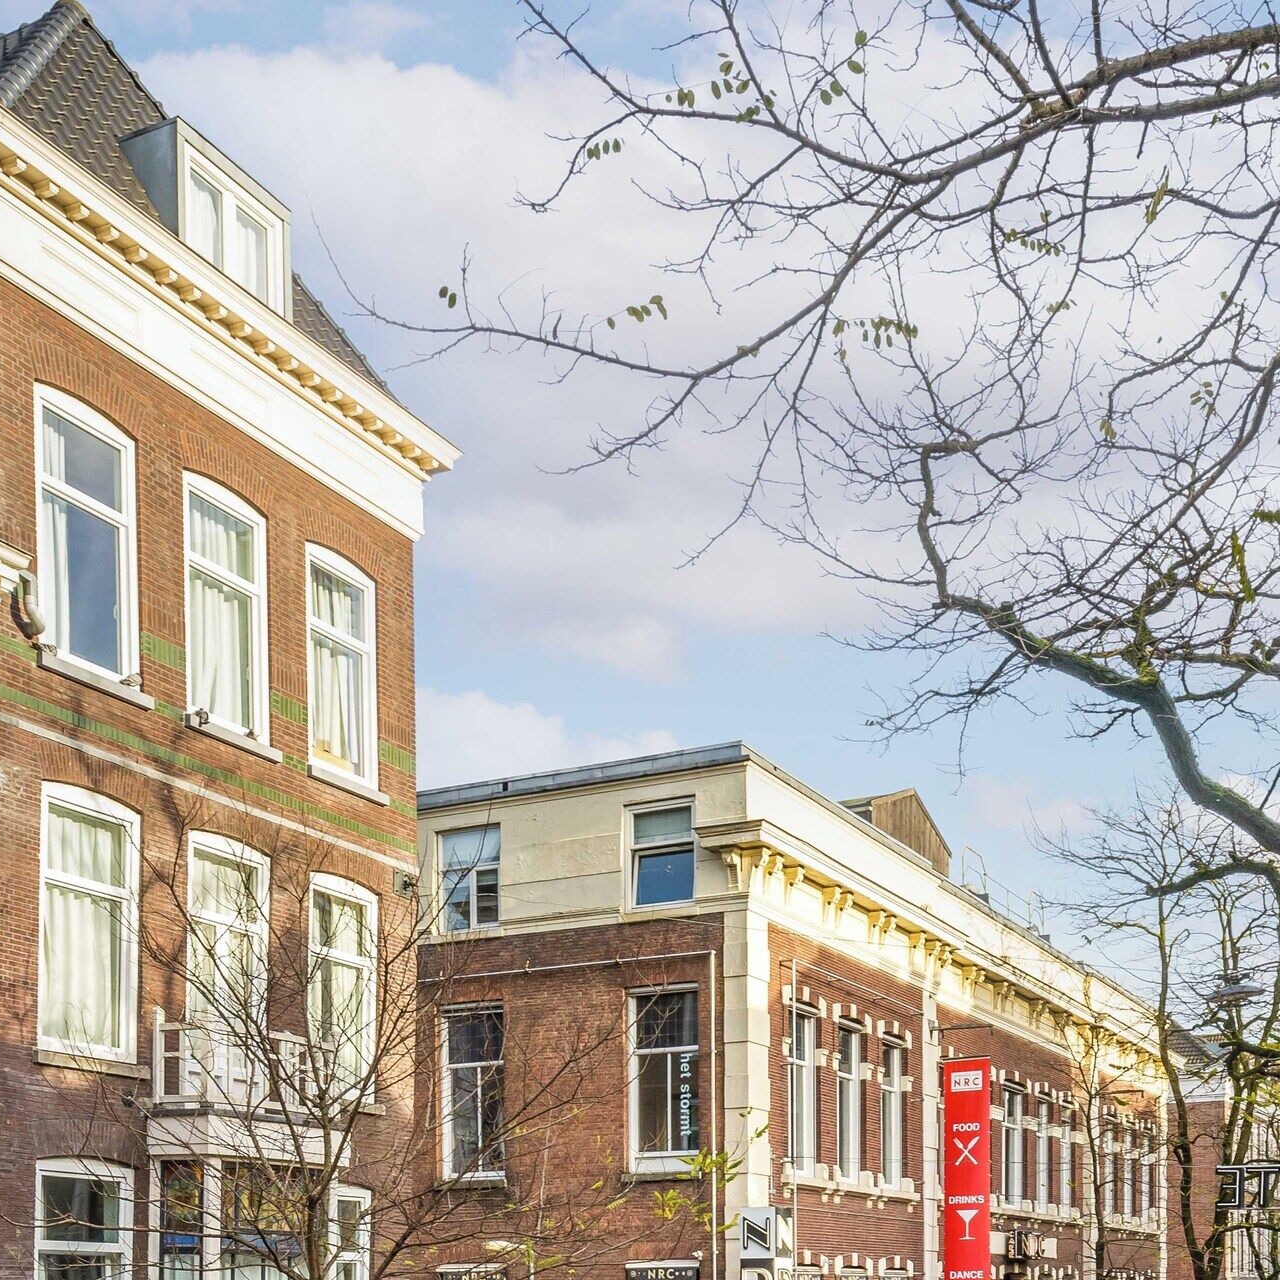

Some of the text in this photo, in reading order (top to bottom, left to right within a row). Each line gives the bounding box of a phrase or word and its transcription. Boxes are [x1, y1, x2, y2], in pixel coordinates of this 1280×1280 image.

[953, 1077, 980, 1088] NRC
[679, 1052, 694, 1137] het stormt
[952, 1122, 980, 1132] FOOD
[948, 1194, 985, 1205] DRINKS
[647, 1268, 675, 1280] NRC
[949, 1270, 984, 1279] DANCE
